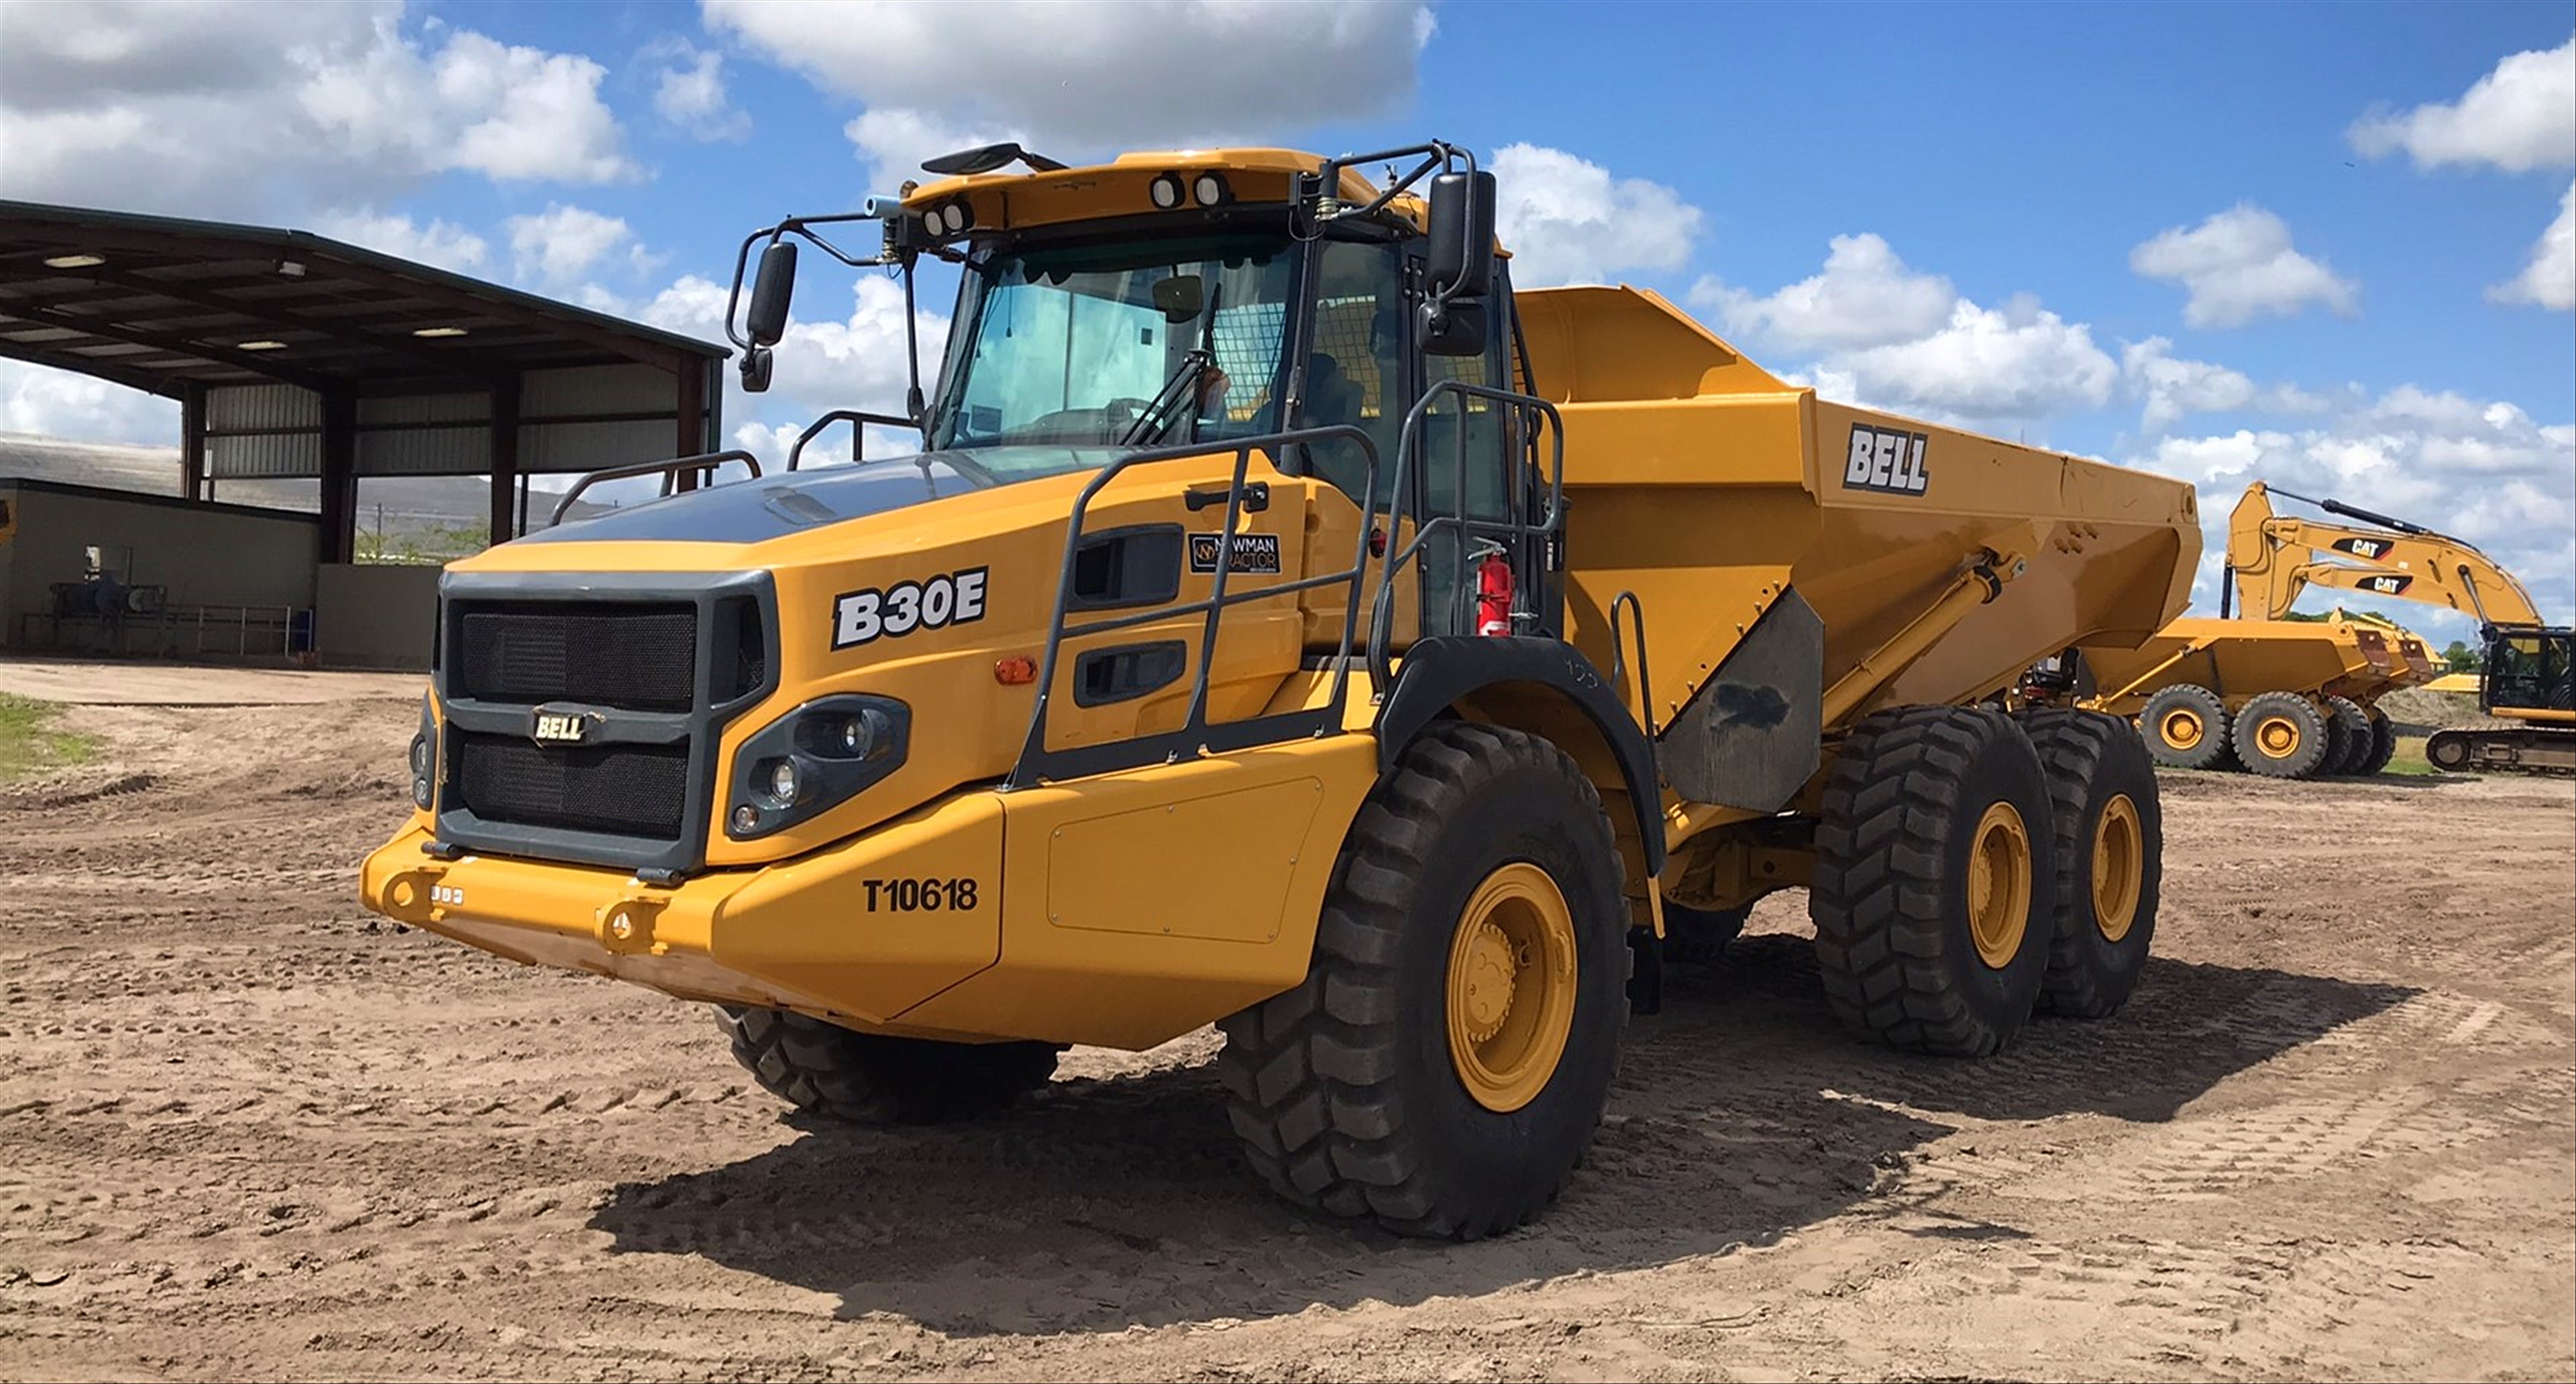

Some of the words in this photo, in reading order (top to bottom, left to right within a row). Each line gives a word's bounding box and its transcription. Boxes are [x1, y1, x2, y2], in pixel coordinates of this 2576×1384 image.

[1845, 428, 1927, 492] BELL
[1215, 537, 1275, 552] NWMAN
[2352, 539, 2379, 557] CAT
[1216, 552, 1276, 568] RACTOR
[2374, 577, 2399, 594] CAT
[835, 570, 986, 647] B30E
[535, 715, 582, 741] BELL
[862, 877, 978, 912] T10618
